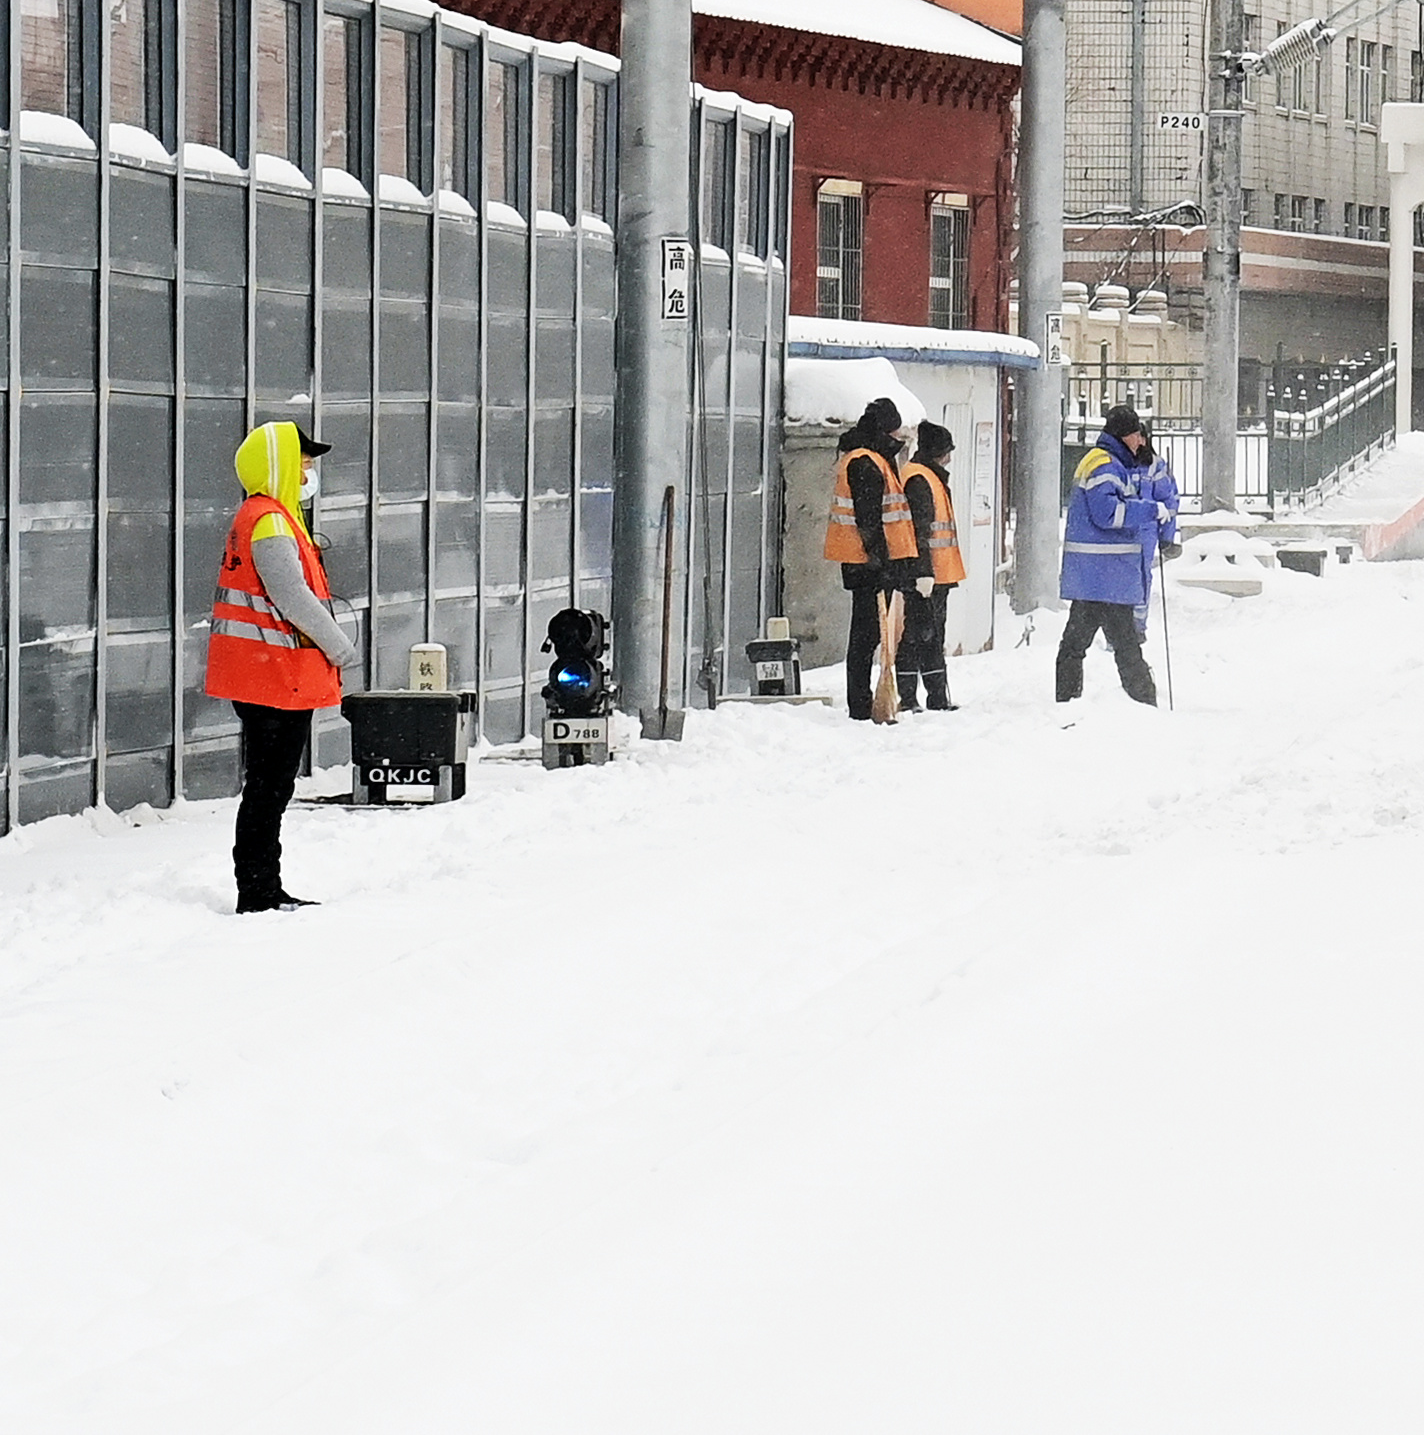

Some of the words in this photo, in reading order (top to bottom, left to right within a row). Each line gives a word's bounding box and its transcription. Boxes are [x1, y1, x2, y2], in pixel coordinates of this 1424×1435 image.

[1160, 116, 1200, 129] P240
[553, 722, 570, 740] D
[574, 728, 600, 739] 788
[369, 768, 431, 783] QKJC
